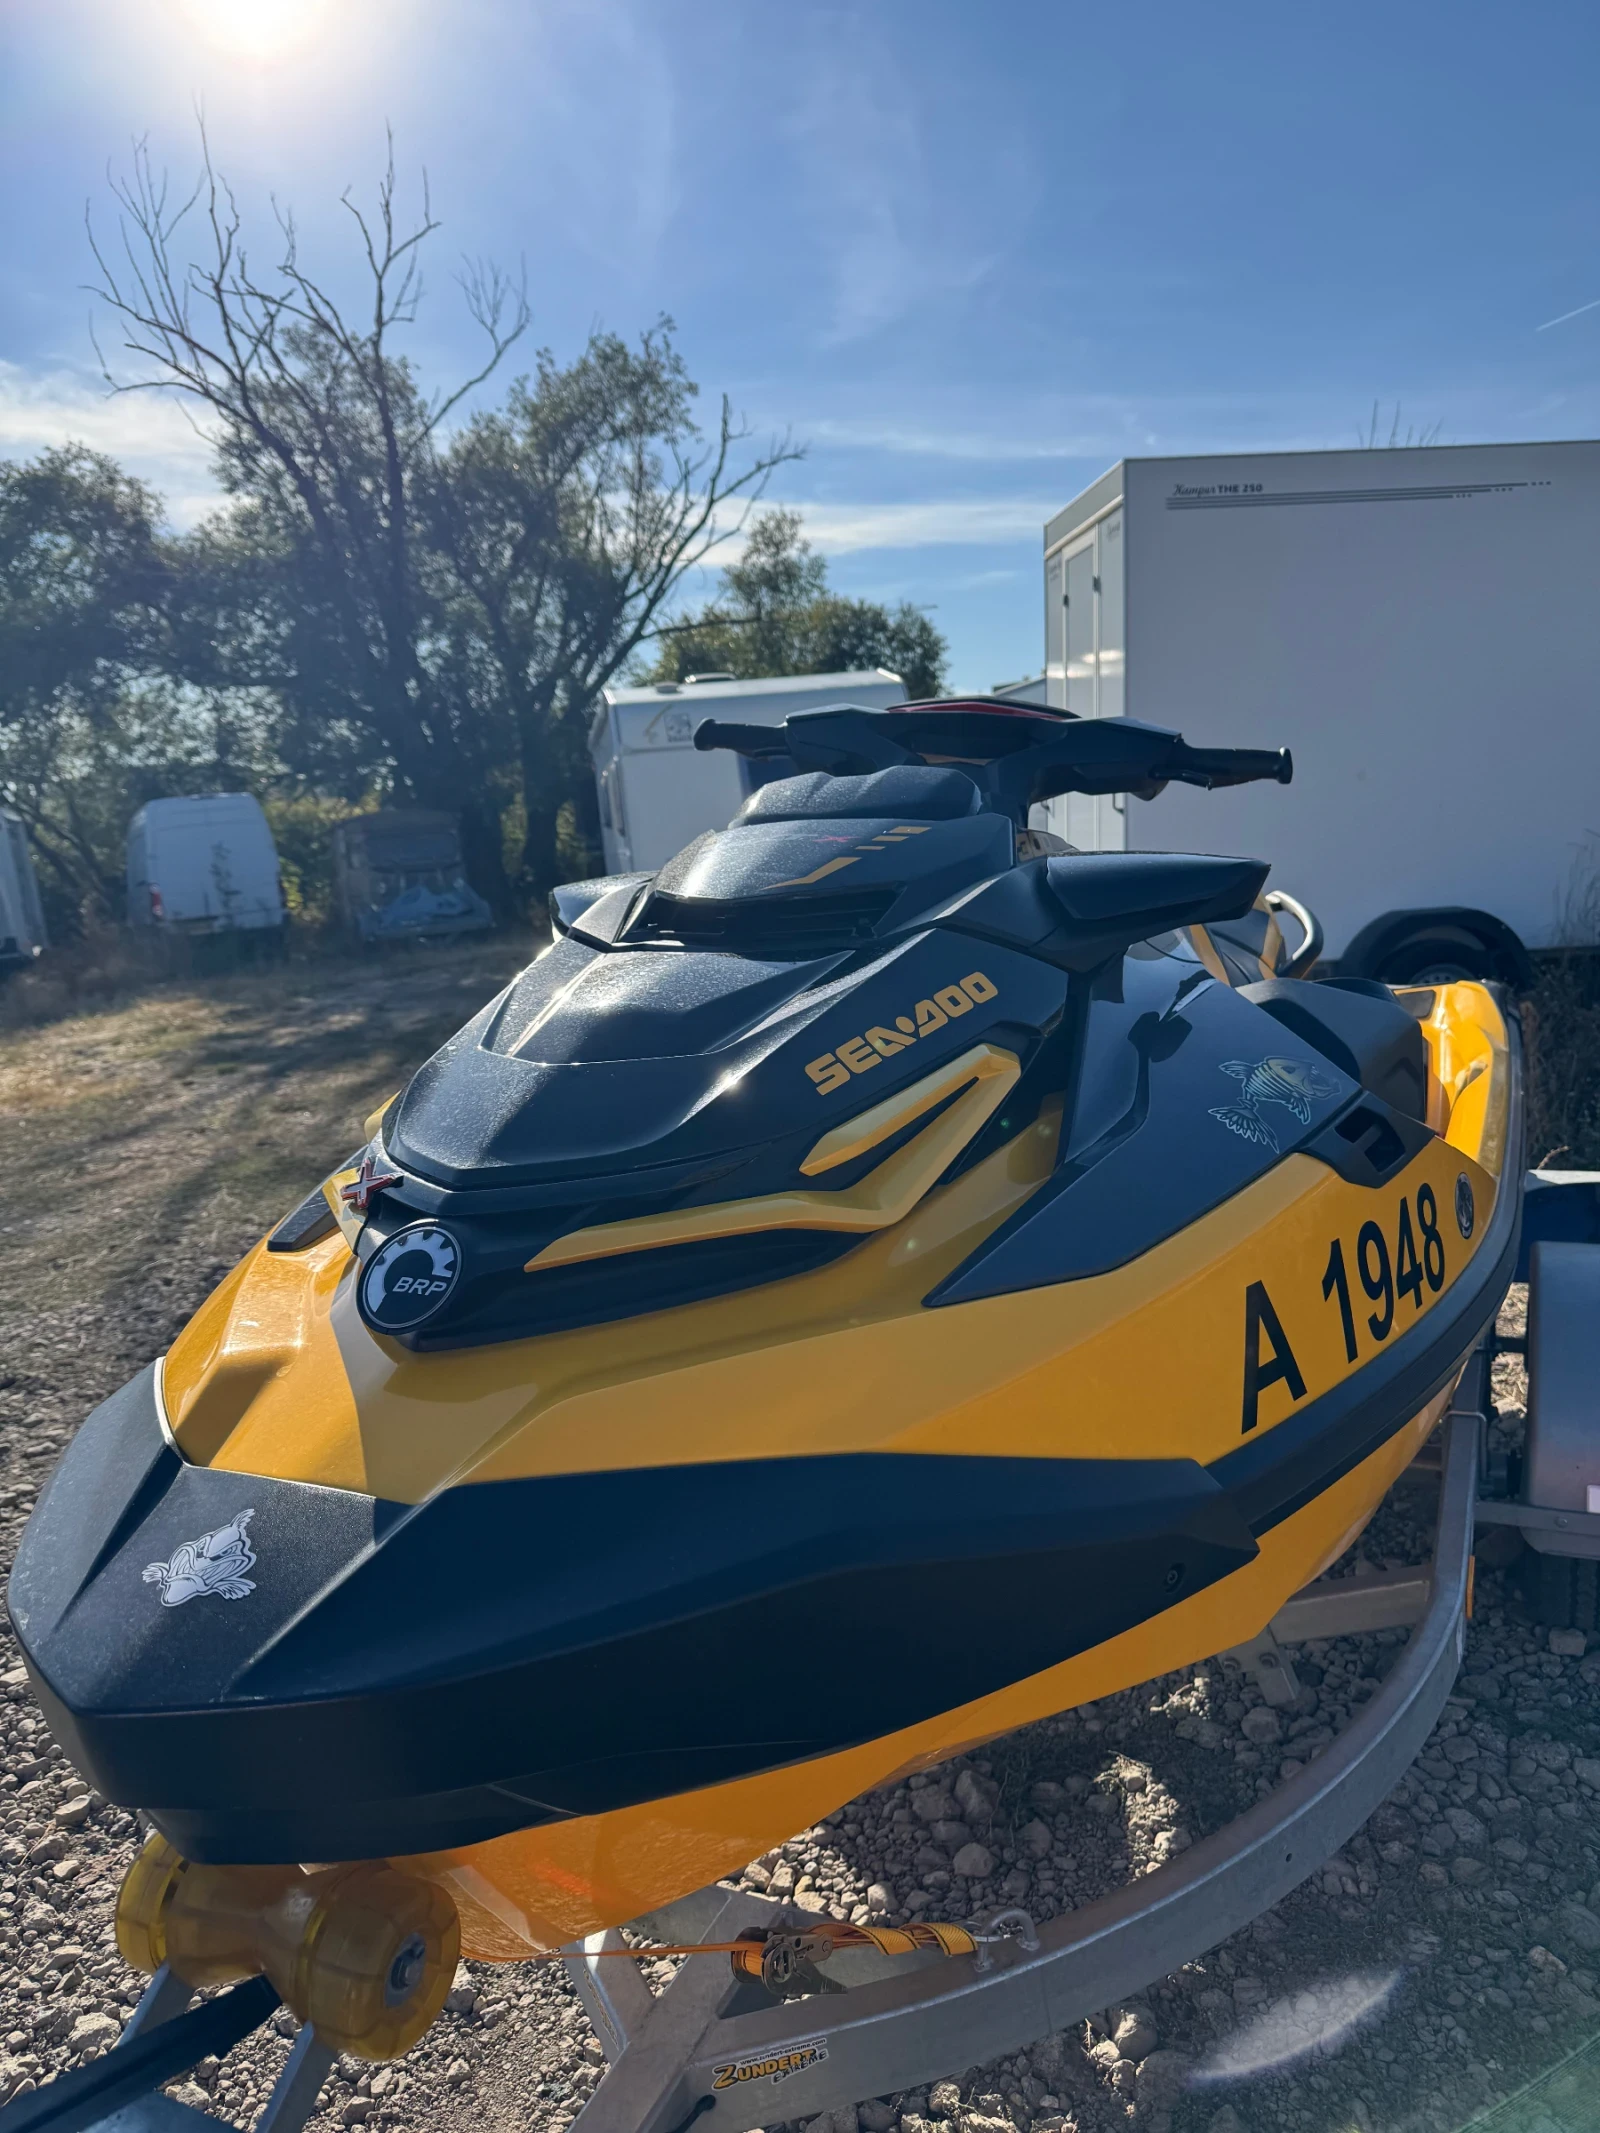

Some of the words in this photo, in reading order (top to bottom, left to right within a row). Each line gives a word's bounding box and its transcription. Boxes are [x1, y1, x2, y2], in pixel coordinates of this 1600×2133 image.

[392, 1276, 448, 1296] BRP
[1241, 1280, 1308, 1435] A
[1321, 1182, 1445, 1364] 1948
[713, 2048, 817, 2089] ZUNDERT
[773, 2050, 827, 2083] EXTREME
